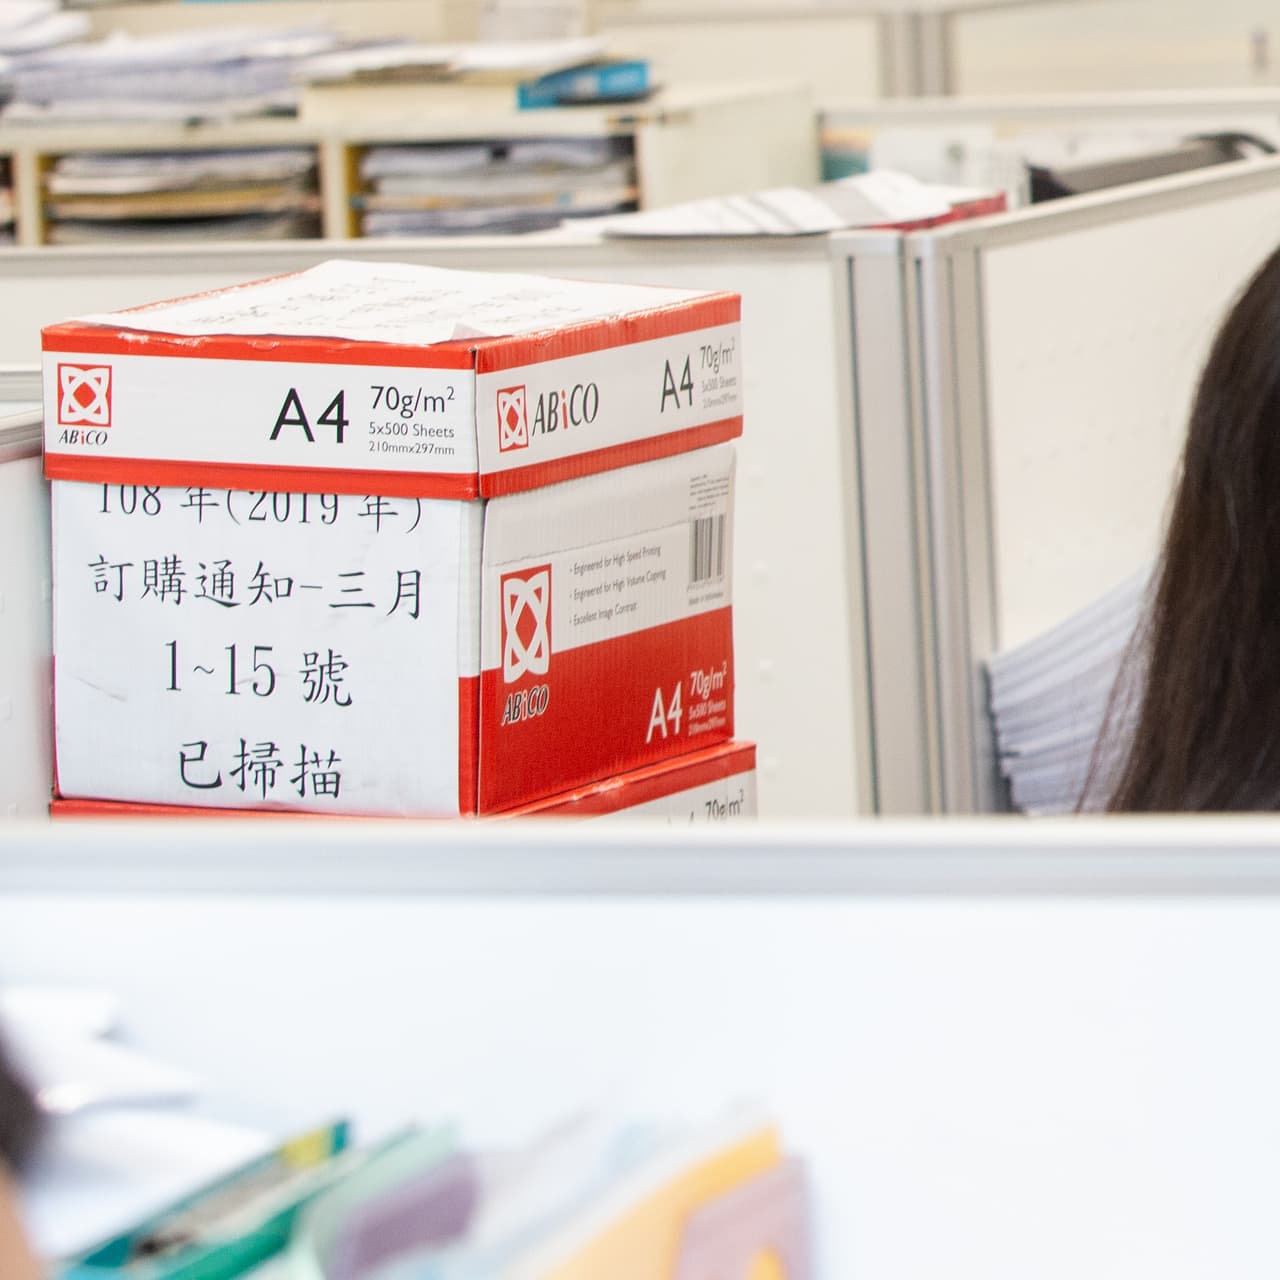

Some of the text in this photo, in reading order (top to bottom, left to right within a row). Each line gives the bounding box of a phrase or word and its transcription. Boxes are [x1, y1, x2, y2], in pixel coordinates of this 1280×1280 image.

[660, 354, 694, 413] A4
[270, 387, 349, 443] A4
[369, 422, 455, 439] 5x500 Sheets
[369, 440, 455, 456] 210mmx297mm
[299, 649, 353, 707] 號
[646, 682, 683, 744] A4
[179, 738, 343, 800] 已掃描
